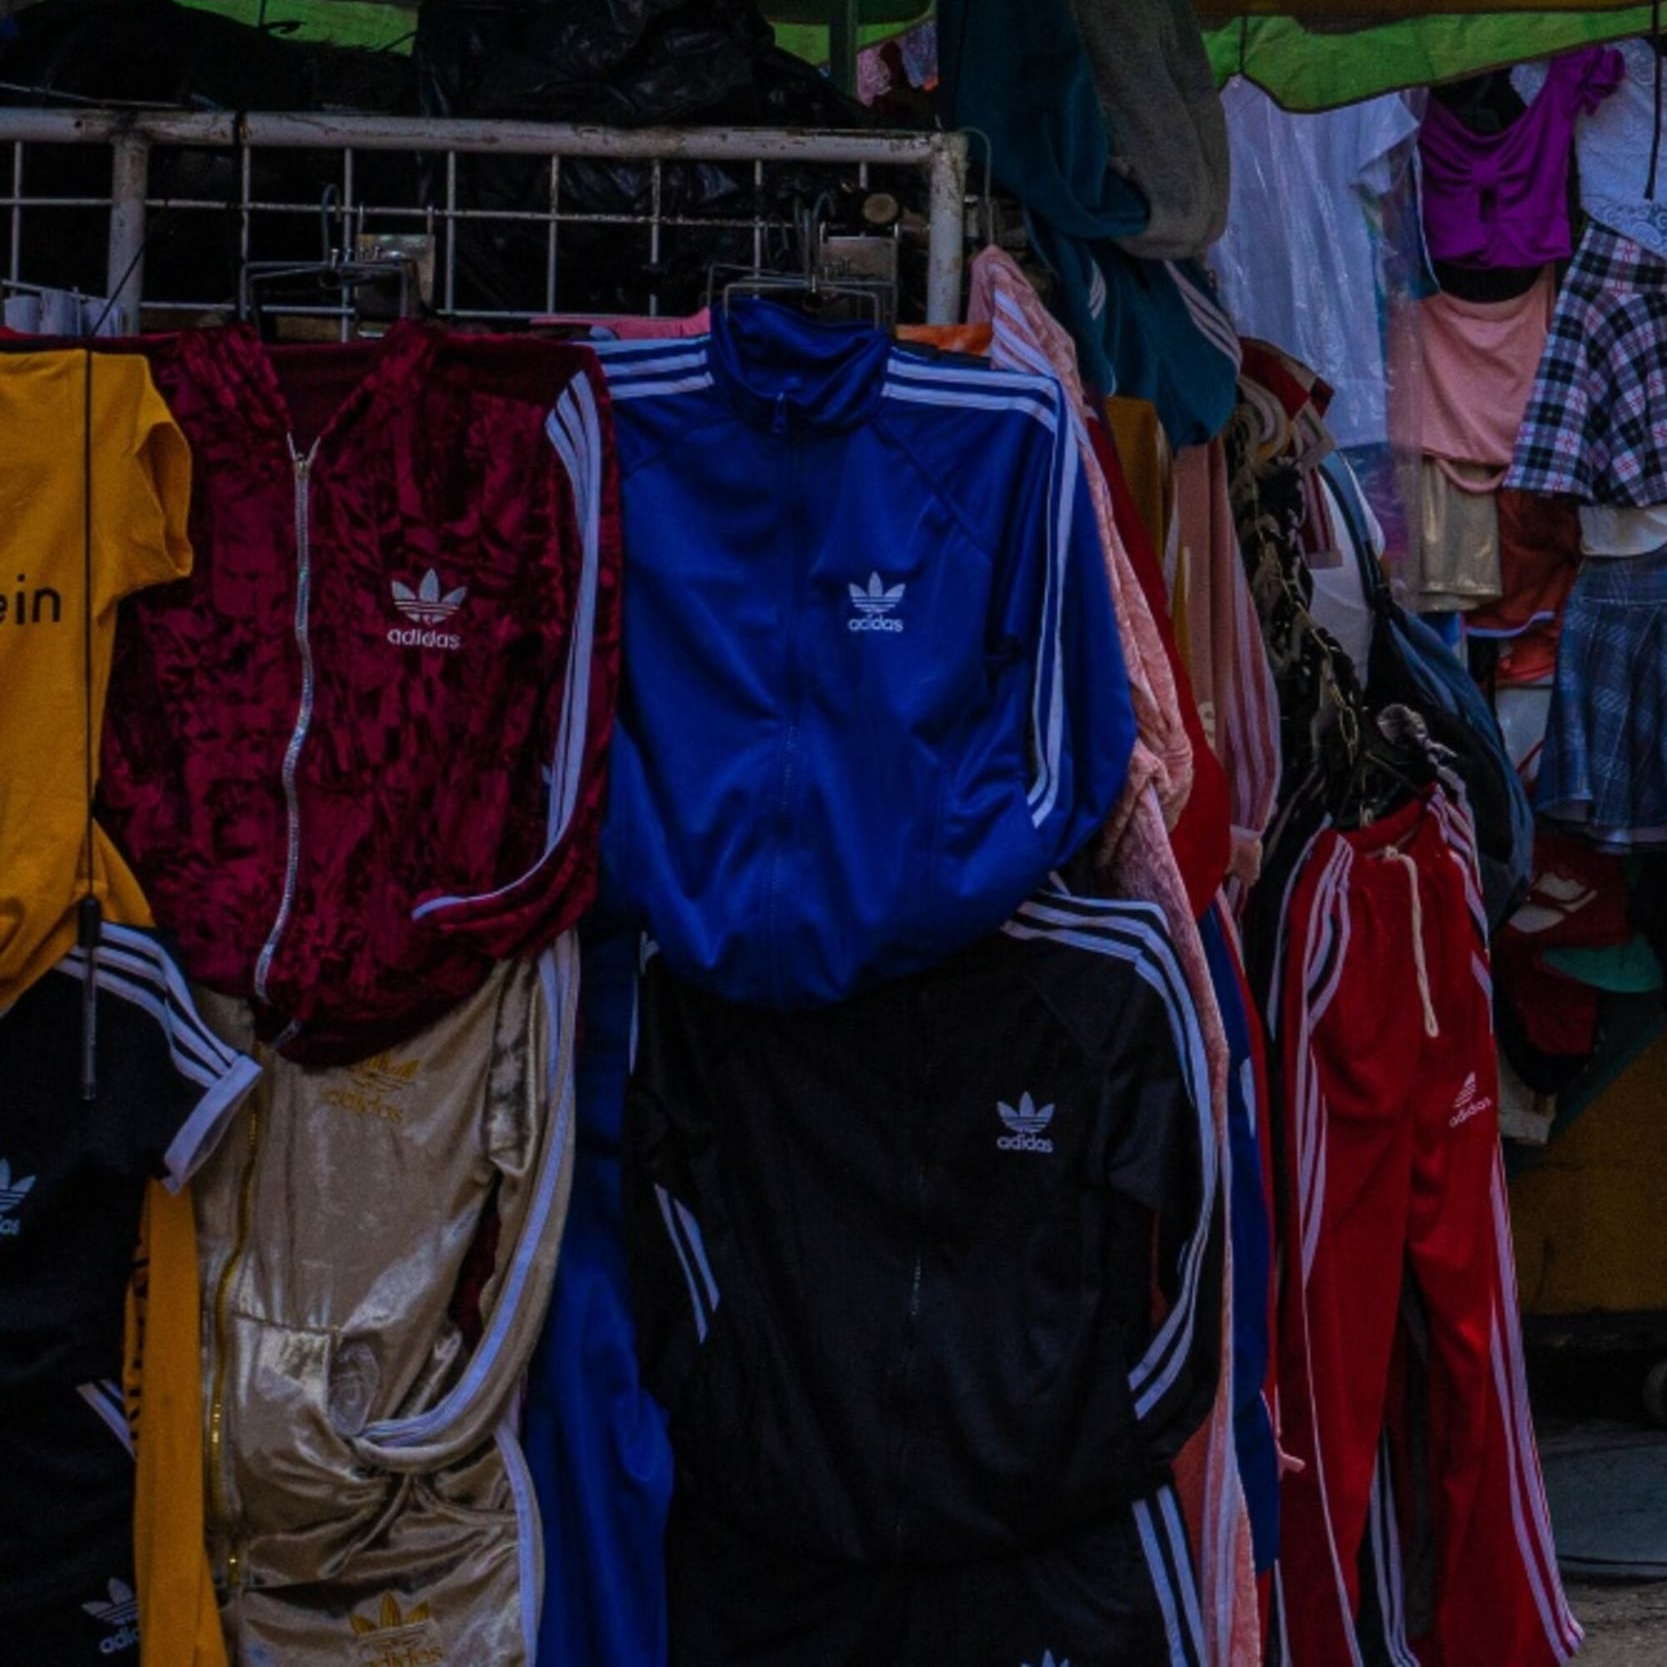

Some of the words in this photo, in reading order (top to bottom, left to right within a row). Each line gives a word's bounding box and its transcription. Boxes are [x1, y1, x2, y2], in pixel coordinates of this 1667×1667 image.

[847, 614, 904, 633] adidas
[386, 628, 461, 651] adidas
[995, 1133, 1054, 1154] adidas
